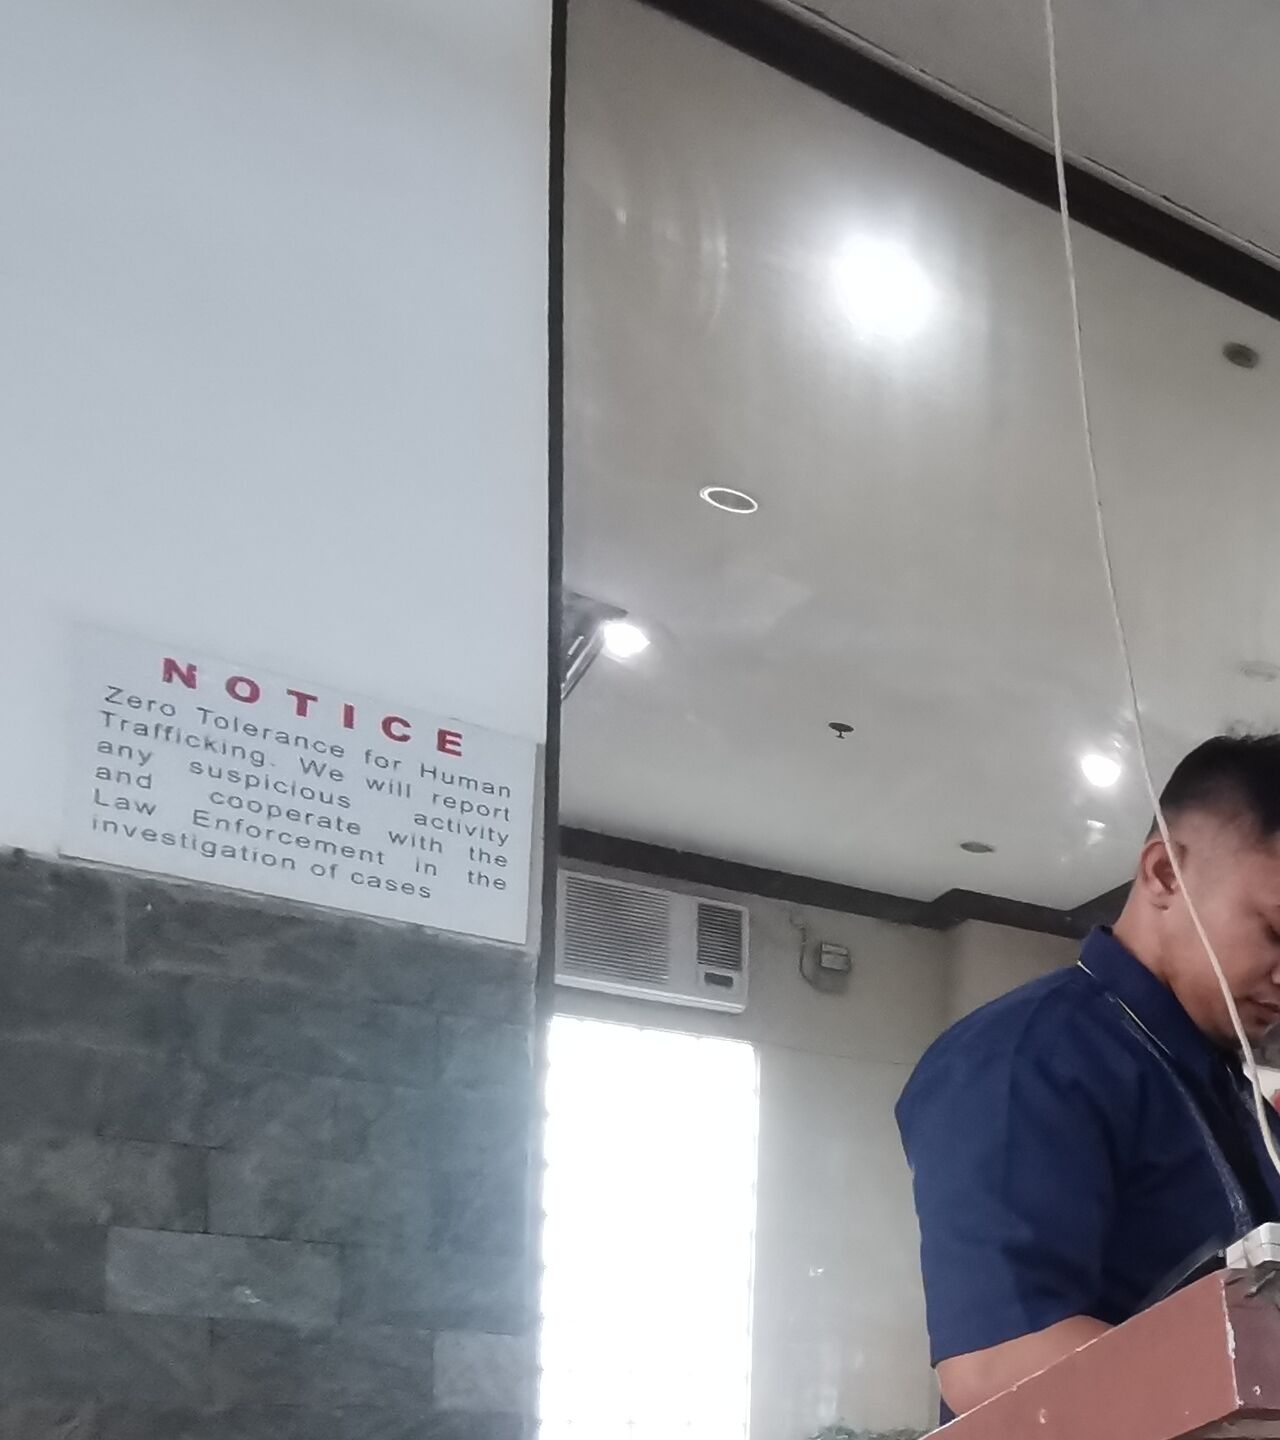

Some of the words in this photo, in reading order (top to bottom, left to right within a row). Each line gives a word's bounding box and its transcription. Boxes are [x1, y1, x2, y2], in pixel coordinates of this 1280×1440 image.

[104, 685, 176, 717] Zero
[196, 706, 345, 758] Tolerance
[364, 749, 402, 769] for
[420, 763, 511, 798] Human
[162, 657, 463, 757] NOTICE
[95, 766, 152, 790] and
[210, 791, 362, 836] cooperate
[388, 830, 443, 853] with
[469, 846, 508, 867] the
[97, 740, 153, 767] any
[189, 760, 352, 809] suspicious
[414, 812, 510, 847] activity
[100, 710, 276, 768] Trafficking.
[300, 756, 345, 782] We
[366, 777, 411, 798] will
[431, 792, 510, 822] report
[92, 817, 296, 872] investigation
[310, 862, 339, 879] of
[350, 871, 432, 899] cases
[93, 788, 157, 816] Law
[192, 809, 386, 865] Enforcement
[415, 857, 437, 876] in
[467, 869, 507, 890] the
